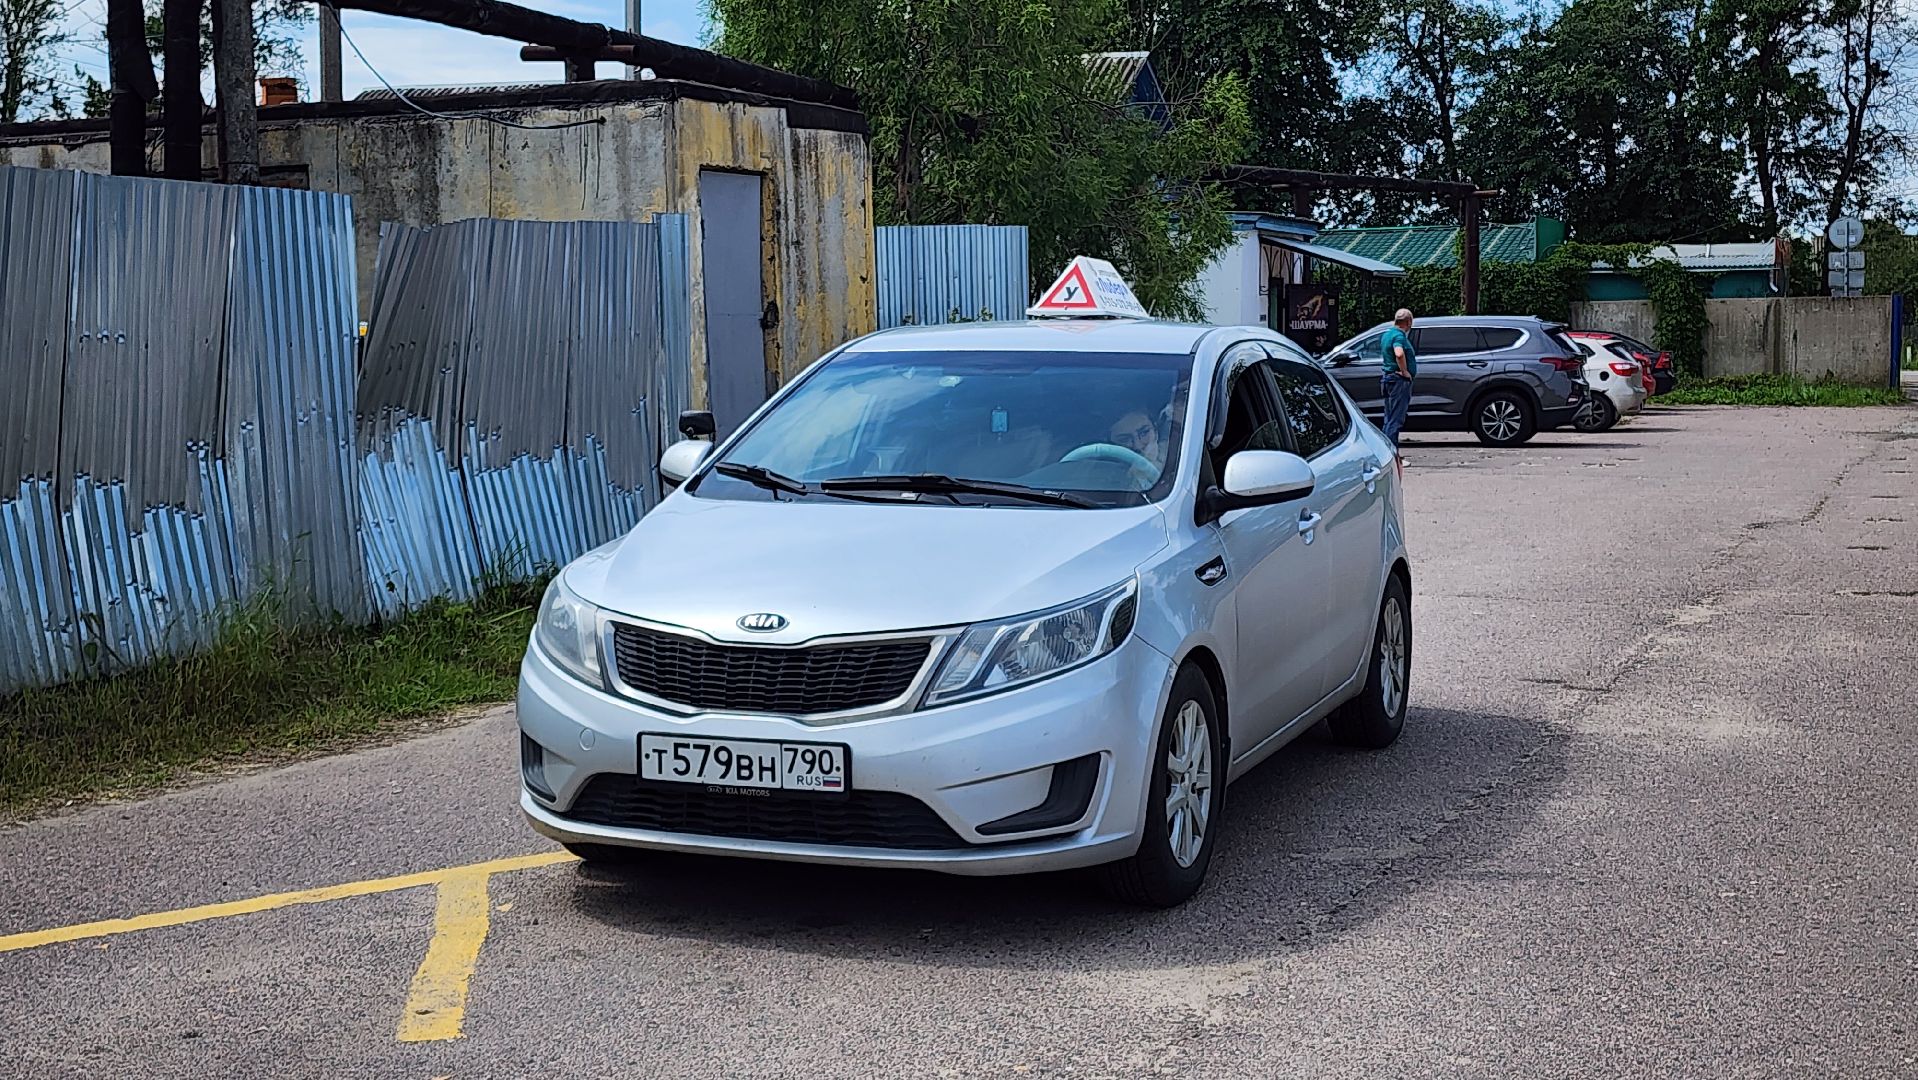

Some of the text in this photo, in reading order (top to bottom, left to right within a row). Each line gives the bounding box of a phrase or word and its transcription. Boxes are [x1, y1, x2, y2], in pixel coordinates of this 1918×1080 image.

[744, 614, 779, 628] KIA
[784, 747, 834, 775] 790
[796, 775, 822, 786] RUS
[725, 787, 739, 795] KIA
[740, 788, 771, 797] MOTORS
